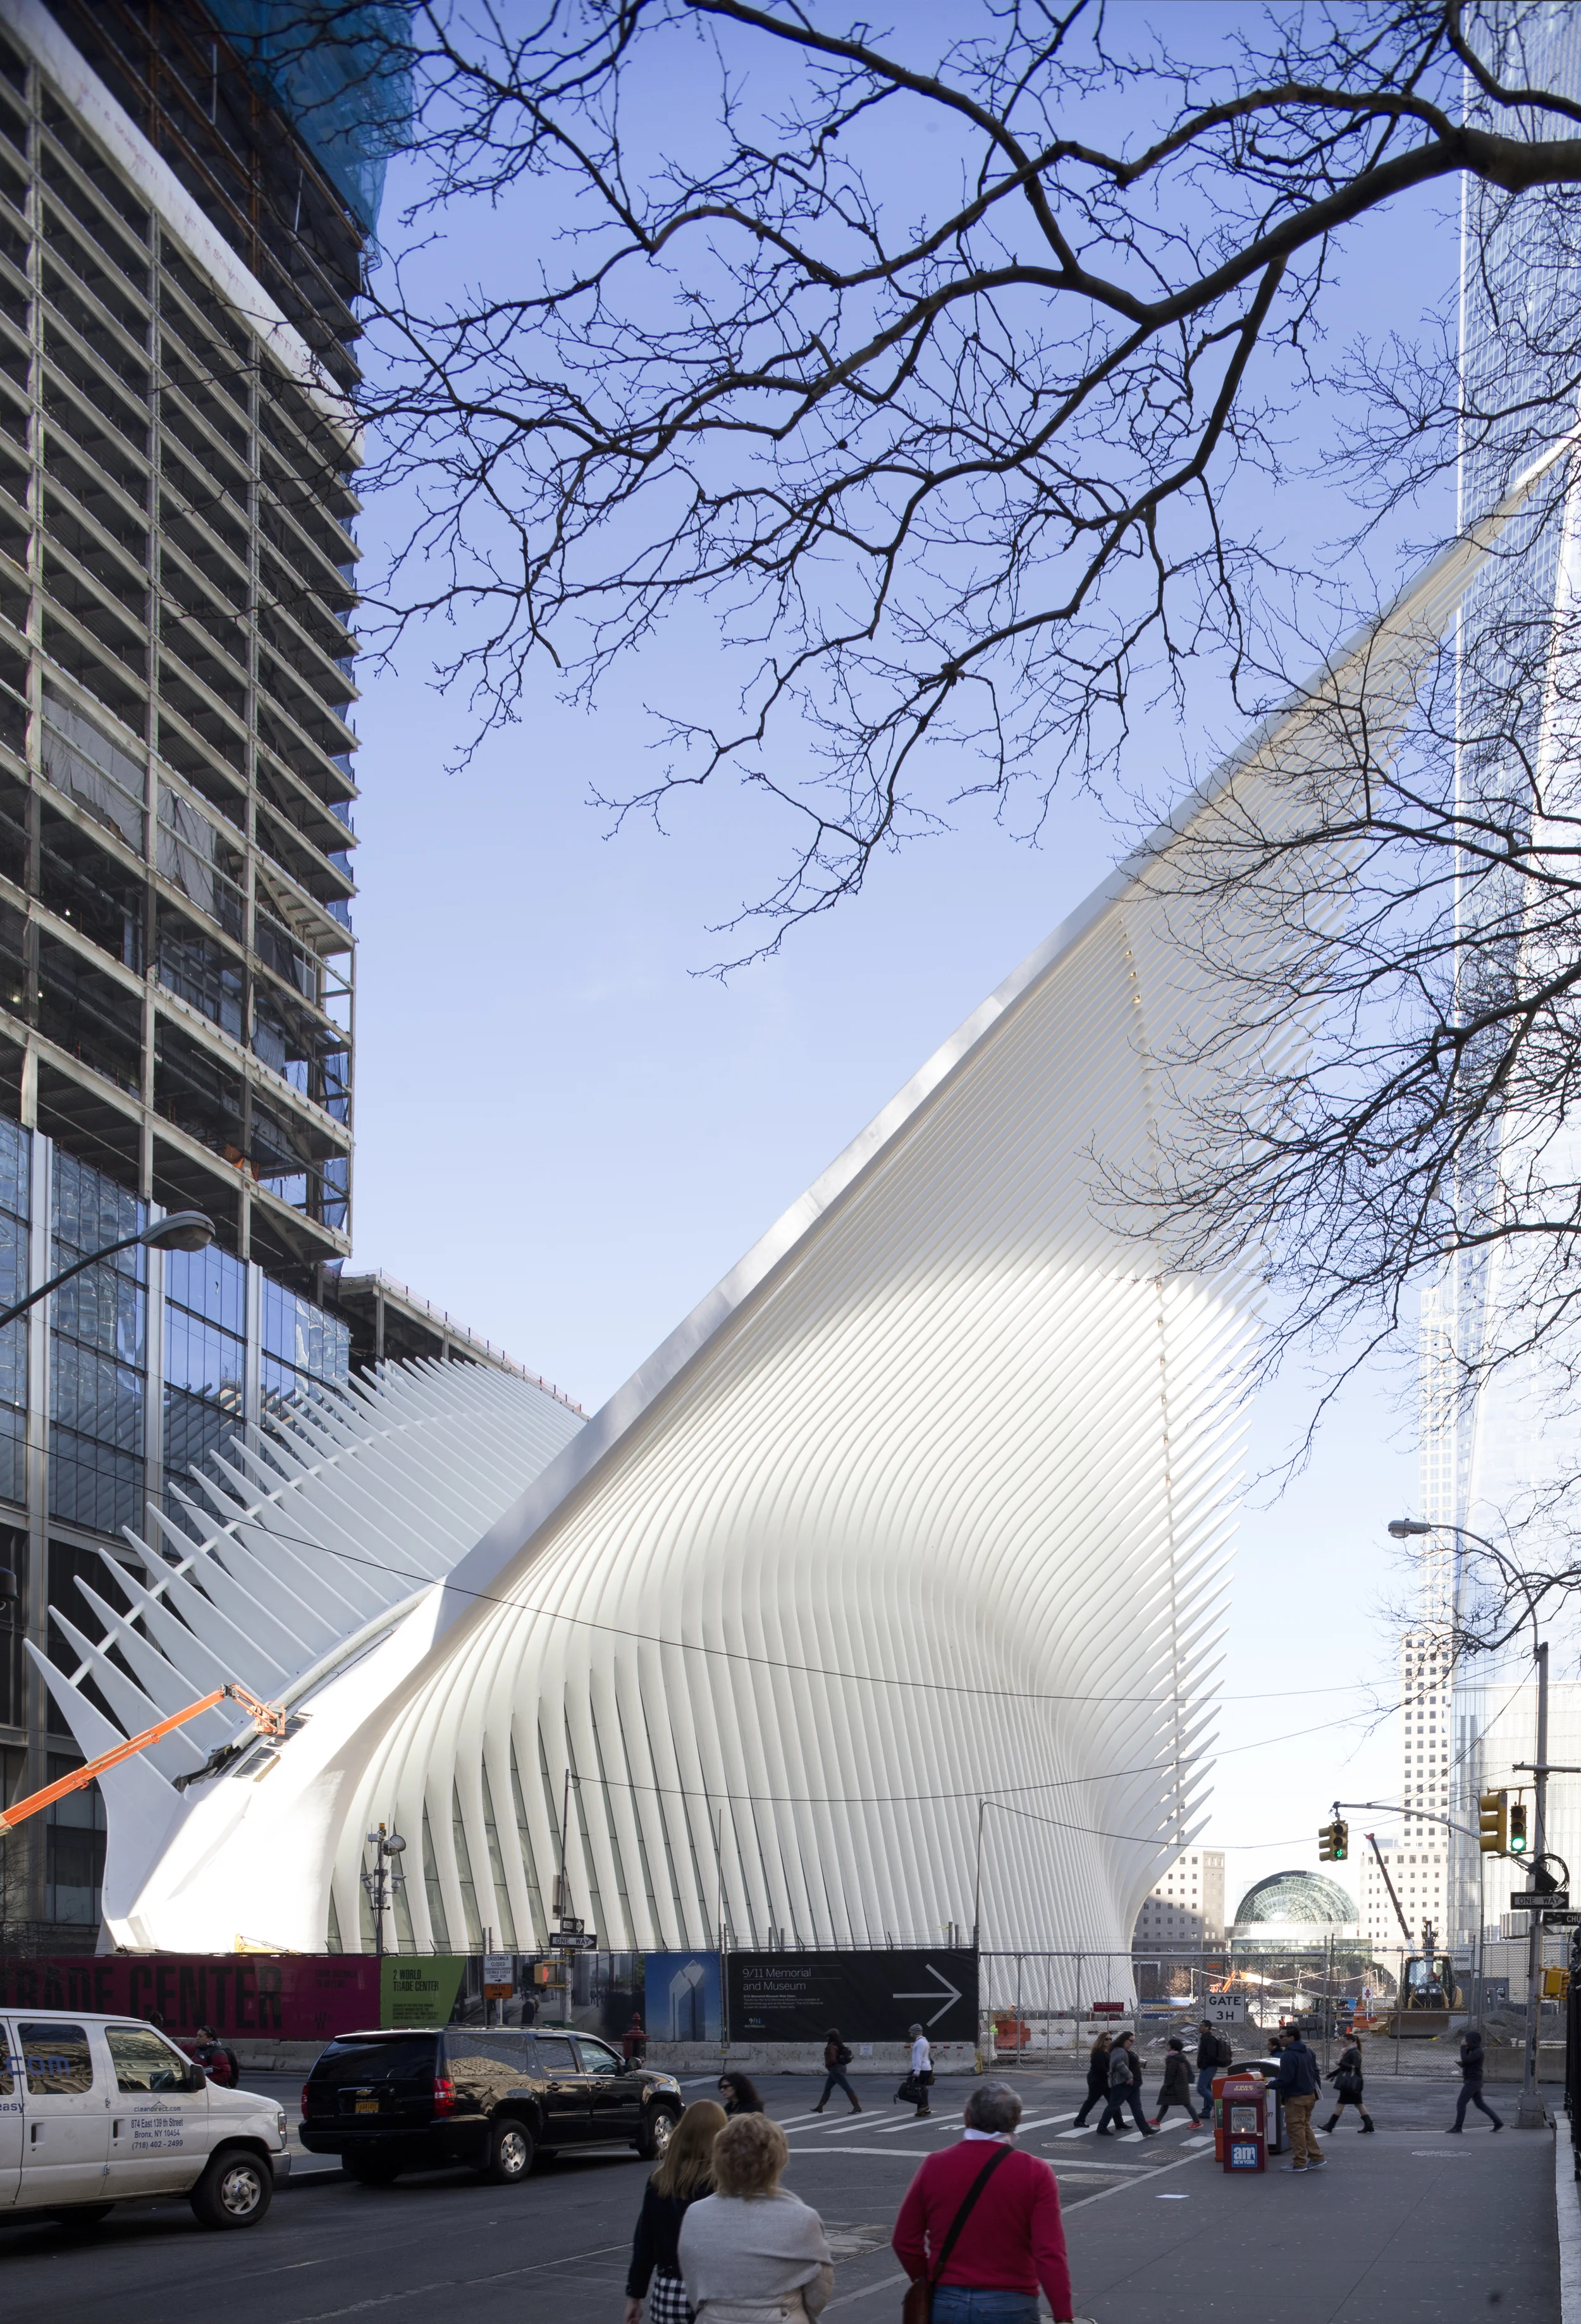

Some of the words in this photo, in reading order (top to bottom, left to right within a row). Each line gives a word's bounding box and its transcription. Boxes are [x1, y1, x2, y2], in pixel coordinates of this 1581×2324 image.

[393, 1969, 397, 1980] 2
[400, 1969, 421, 1980] WORLD
[742, 1968, 763, 1978] 9/11
[766, 1968, 811, 1977] Memorial
[393, 1981, 413, 1991] TRADE
[415, 1981, 439, 1991] CENTER
[743, 1981, 761, 1991] and
[763, 1981, 806, 1990] Museum
[130, 1965, 282, 2031] CENTER
[1209, 1996, 1241, 2005] GATE
[1216, 2011, 1234, 2020] 3H
[131, 2119, 140, 2128] 874
[141, 2118, 152, 2128] East
[154, 2118, 162, 2127] 139
[163, 2118, 168, 2127] th
[169, 2118, 183, 2127] Street
[132, 2141, 149, 2151] (718)
[1233, 2147, 1255, 2160] am
